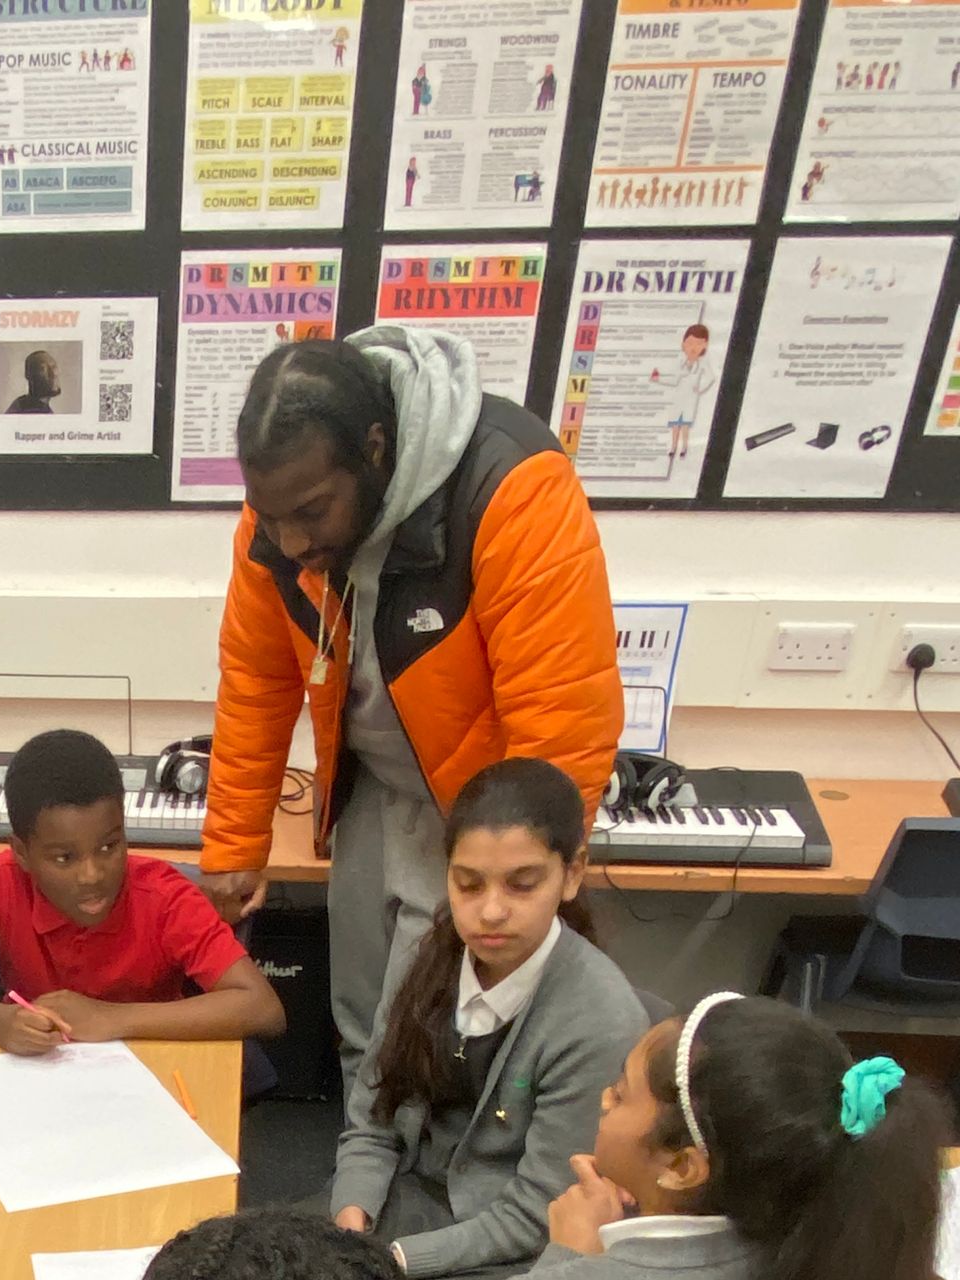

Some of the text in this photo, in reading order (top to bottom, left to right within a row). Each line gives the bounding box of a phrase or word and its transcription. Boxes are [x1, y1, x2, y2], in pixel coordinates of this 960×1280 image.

[624, 22, 681, 39] TIMBRE
[428, 37, 467, 48] STRINGS
[499, 34, 560, 46] WOODWIND
[28, 52, 72, 67] MUSIC
[613, 73, 689, 91] TONALITY
[712, 71, 767, 88] TEMPO
[201, 98, 230, 110] PITCH
[251, 96, 284, 109] SCALE
[299, 95, 346, 107] INTERVAL
[423, 129, 452, 140] BRASS
[488, 127, 547, 138] PERCUSSION
[195, 138, 226, 150] TREBLE
[236, 137, 261, 149] BASS
[270, 136, 292, 148] FLAT
[311, 135, 344, 148] SHARP
[21, 140, 138, 158] CLASSICAL MUSIC
[198, 167, 258, 180] ASCENDING
[272, 166, 338, 178] DESCENDING
[203, 195, 259, 208] CONJUNCT
[268, 195, 316, 207] DISJUNCT
[582, 271, 737, 293] DR SMITH
[184, 292, 333, 315] DYNAMICS
[393, 287, 525, 310] RHYTHM
[0, 310, 81, 329] STORMZY
[14, 431, 121, 442] Rapper and Grime Artist
